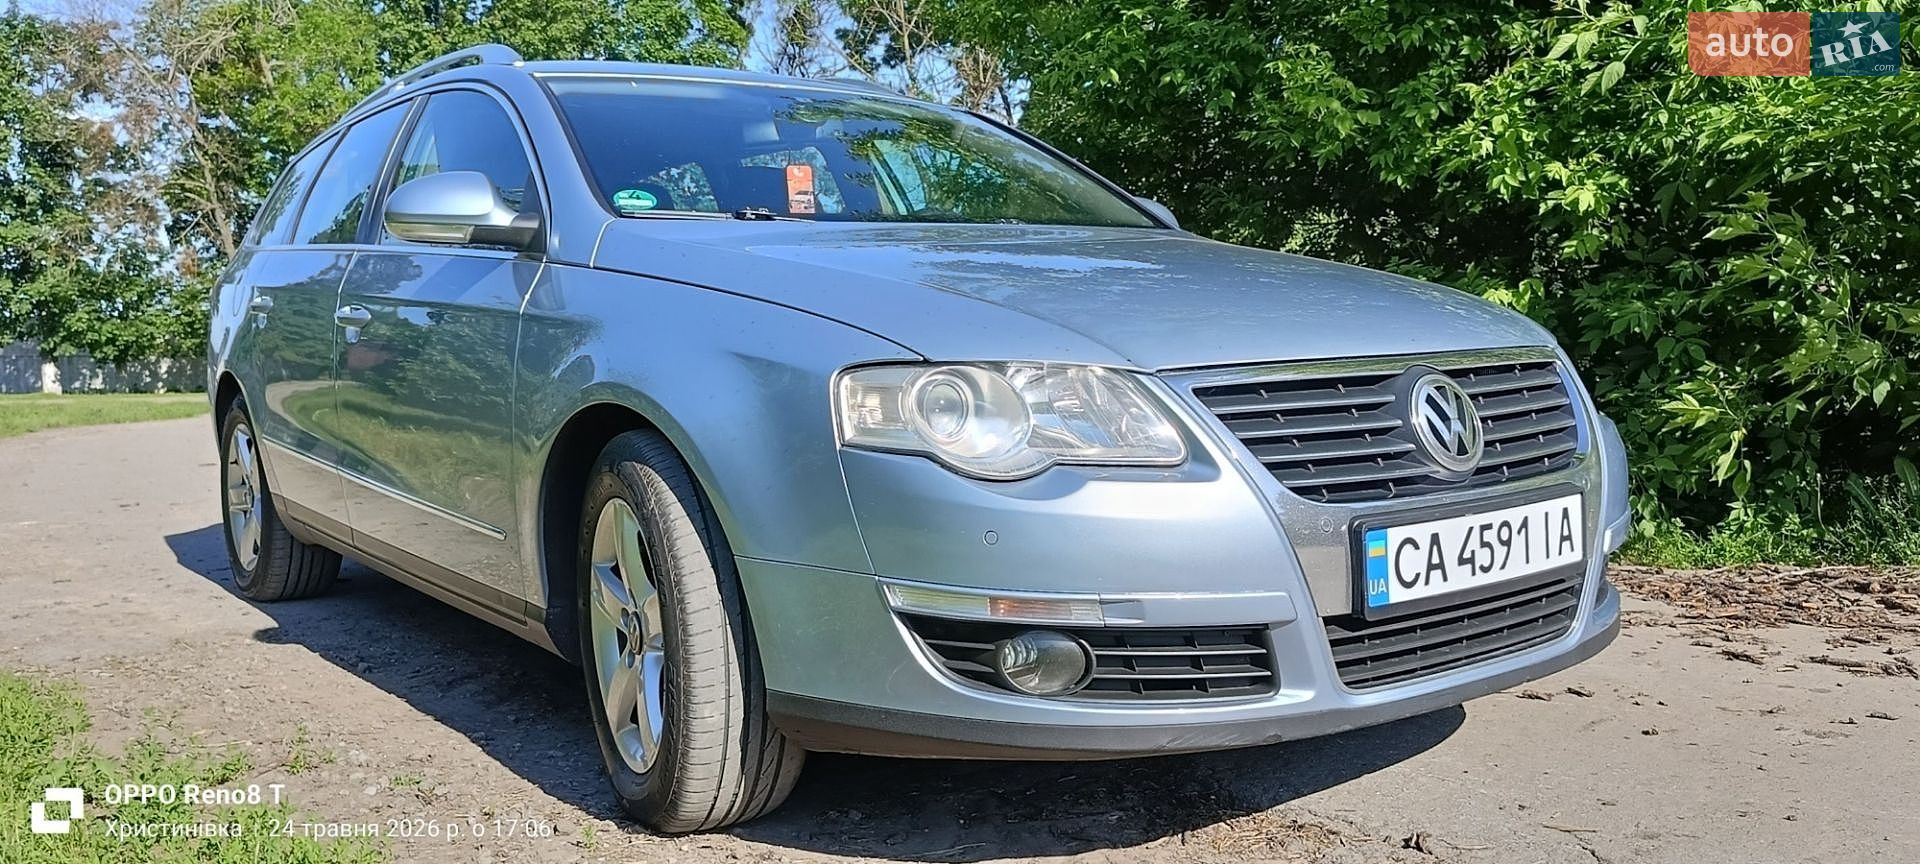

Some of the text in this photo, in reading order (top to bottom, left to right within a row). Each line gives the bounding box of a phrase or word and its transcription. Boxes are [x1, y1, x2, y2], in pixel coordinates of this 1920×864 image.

[1394, 506, 1575, 589] CA 4591 IA
[1369, 578, 1387, 595] UA
